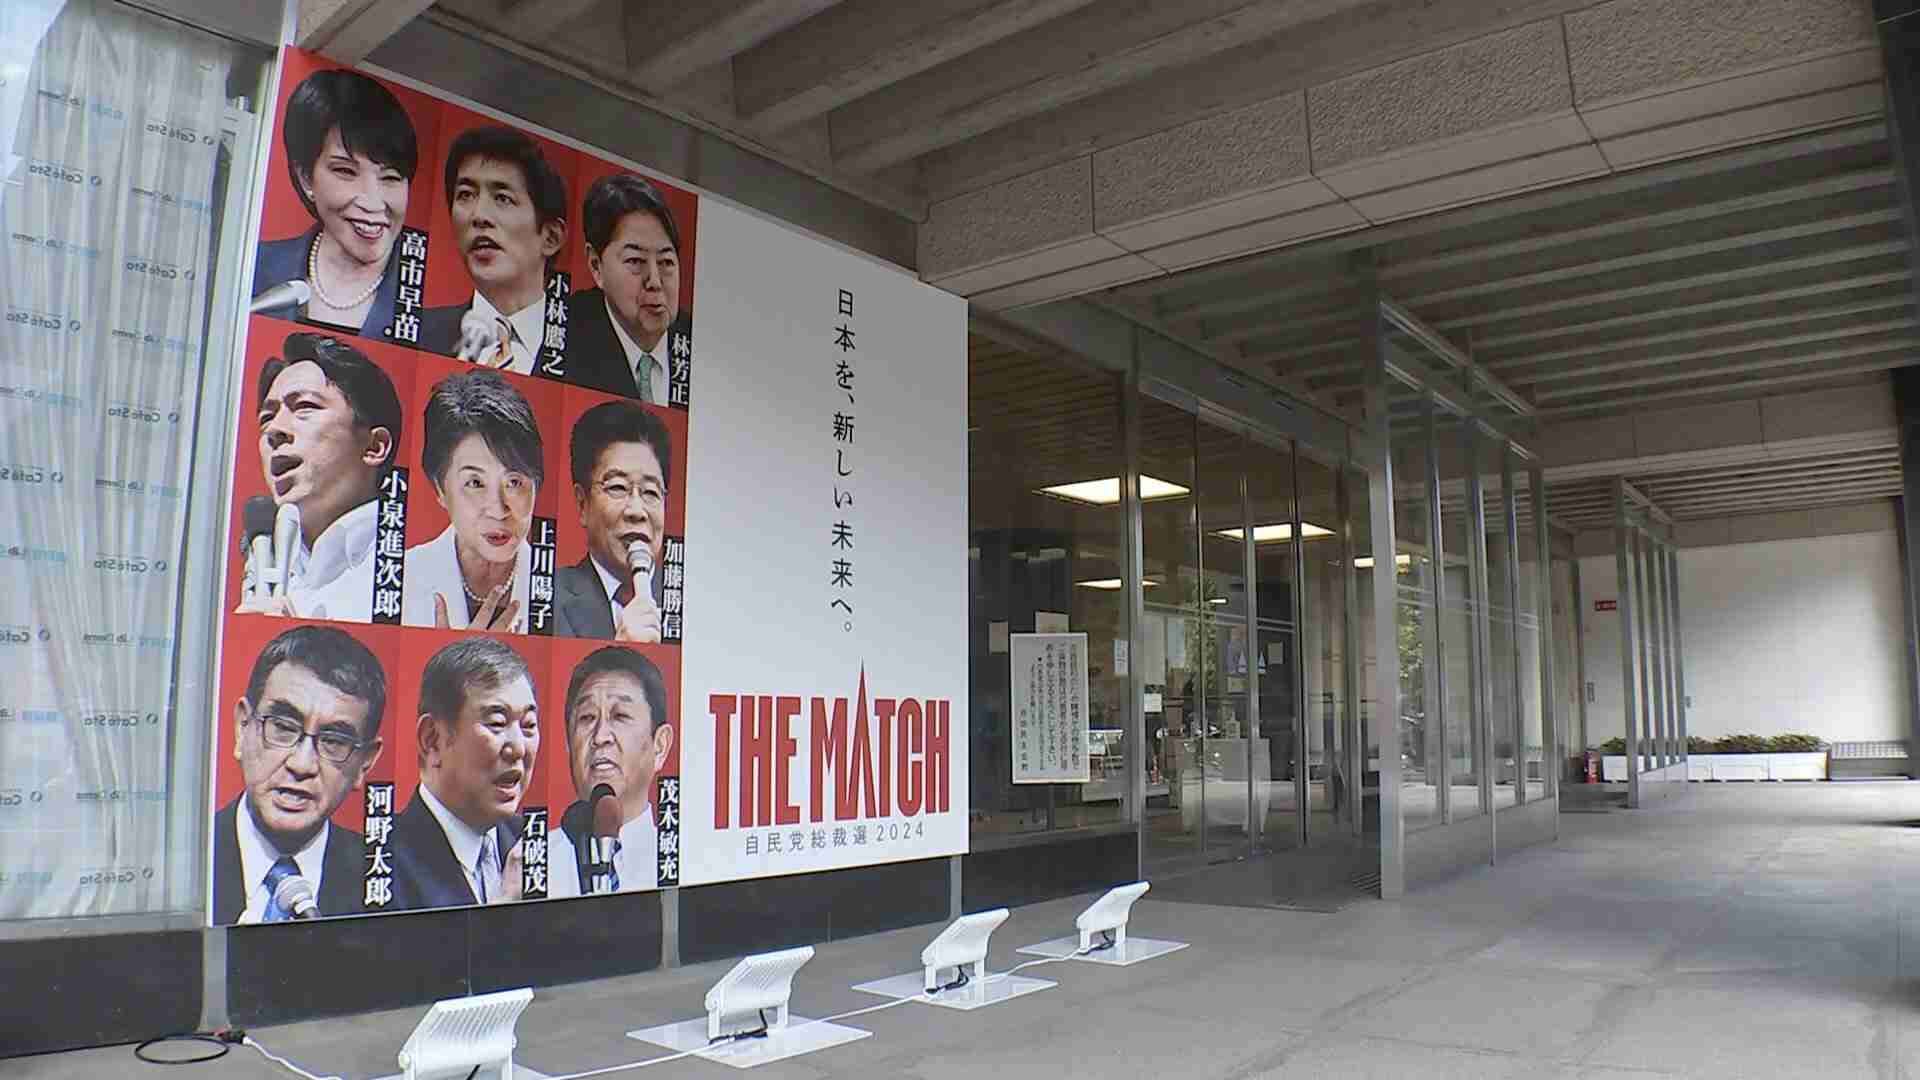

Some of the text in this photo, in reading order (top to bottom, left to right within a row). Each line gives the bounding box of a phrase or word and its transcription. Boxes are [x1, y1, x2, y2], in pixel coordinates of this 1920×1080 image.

[394, 231, 427, 342] 高市早苗
[542, 274, 569, 376] 小林鷹之
[672, 332, 691, 405] 林芳正
[832, 288, 856, 632] 日本を、新しい未来へ。
[373, 470, 408, 618] 小泉進次郎
[529, 520, 555, 629] 上川陽子
[661, 538, 684, 639] 加藤勝信
[709, 694, 801, 830] THE
[809, 656, 950, 824] MATCH
[363, 783, 394, 907] 河野太郎
[521, 810, 548, 894] 石破茂
[658, 778, 680, 881] 茂木敏充
